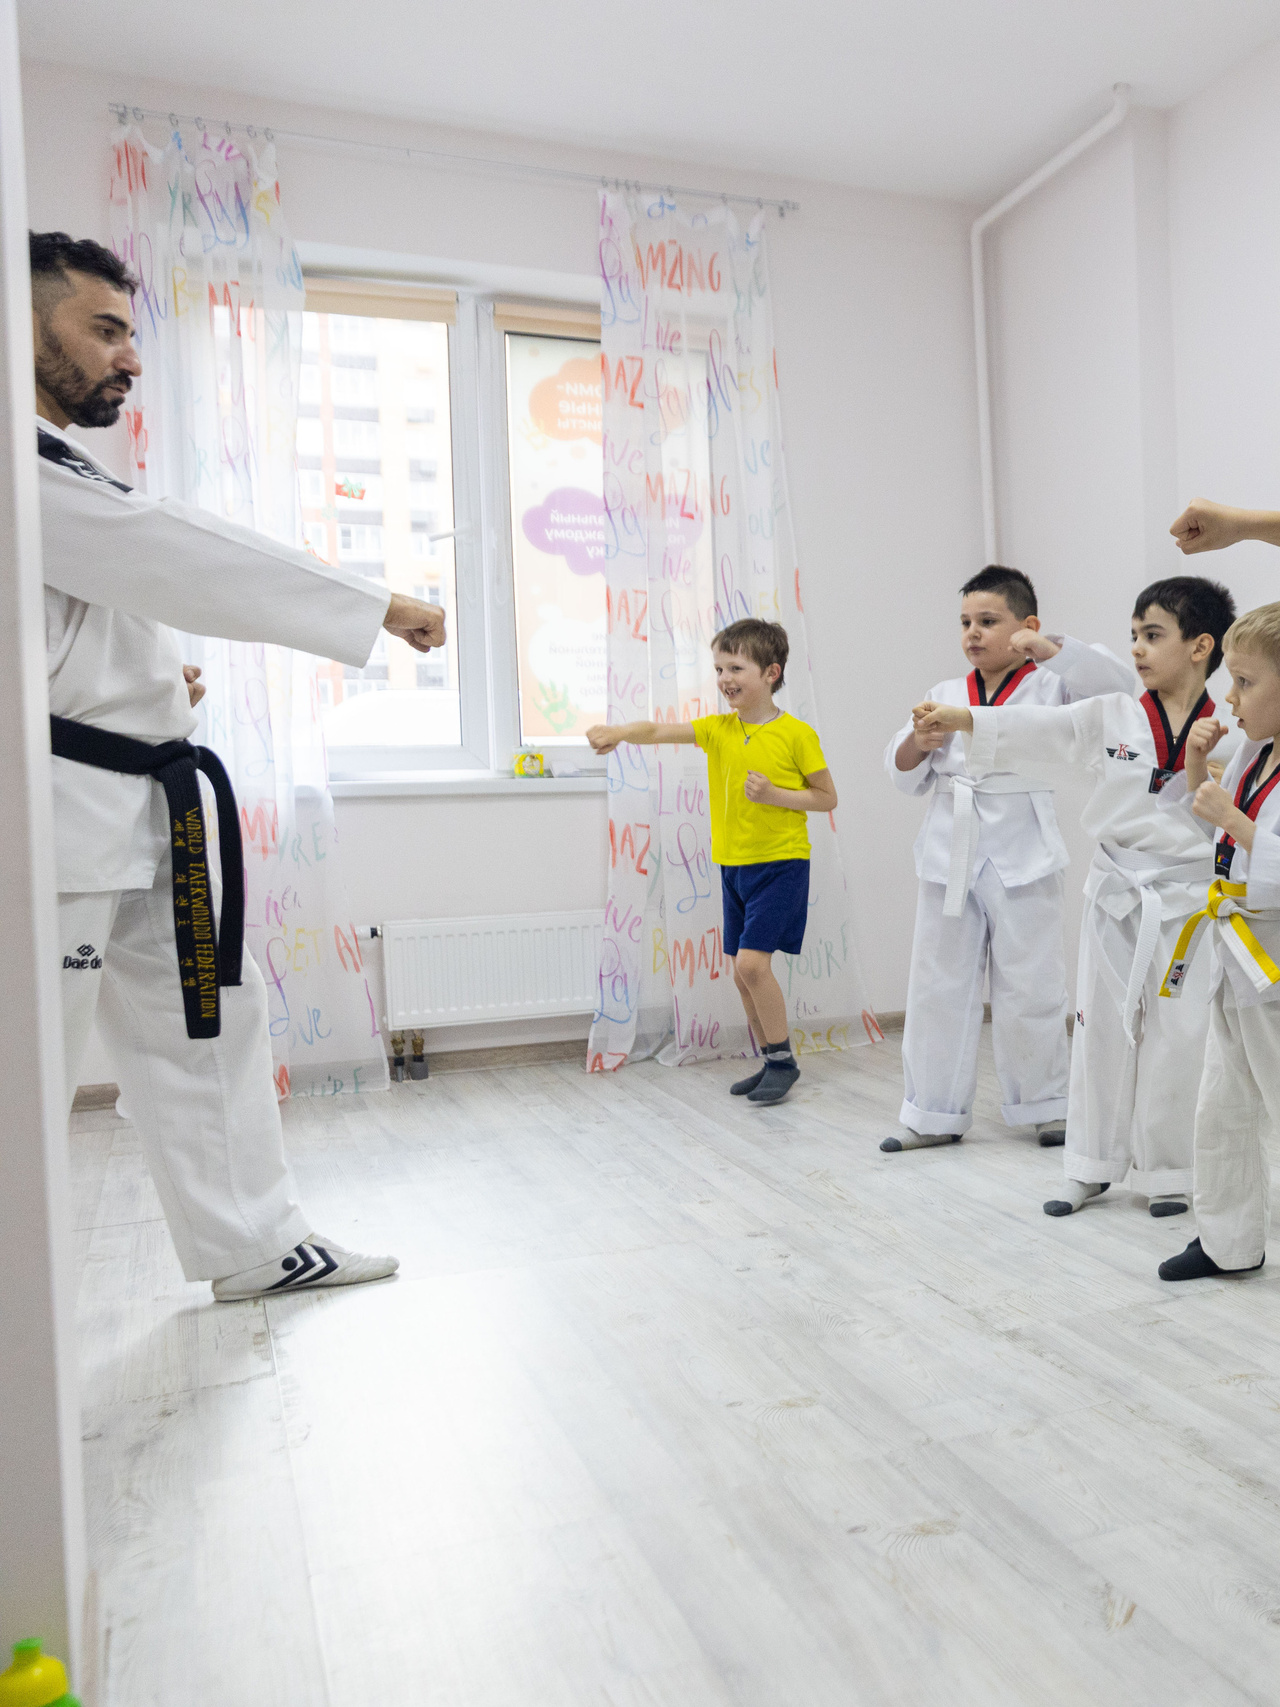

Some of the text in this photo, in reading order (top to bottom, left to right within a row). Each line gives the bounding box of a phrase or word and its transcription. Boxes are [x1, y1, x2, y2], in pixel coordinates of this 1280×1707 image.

[601, 429, 644, 475] ive
[606, 662, 646, 709] ive
[185, 806, 217, 1018] WORLD TAEKWONDO FEDERATION
[604, 894, 643, 944] ive
